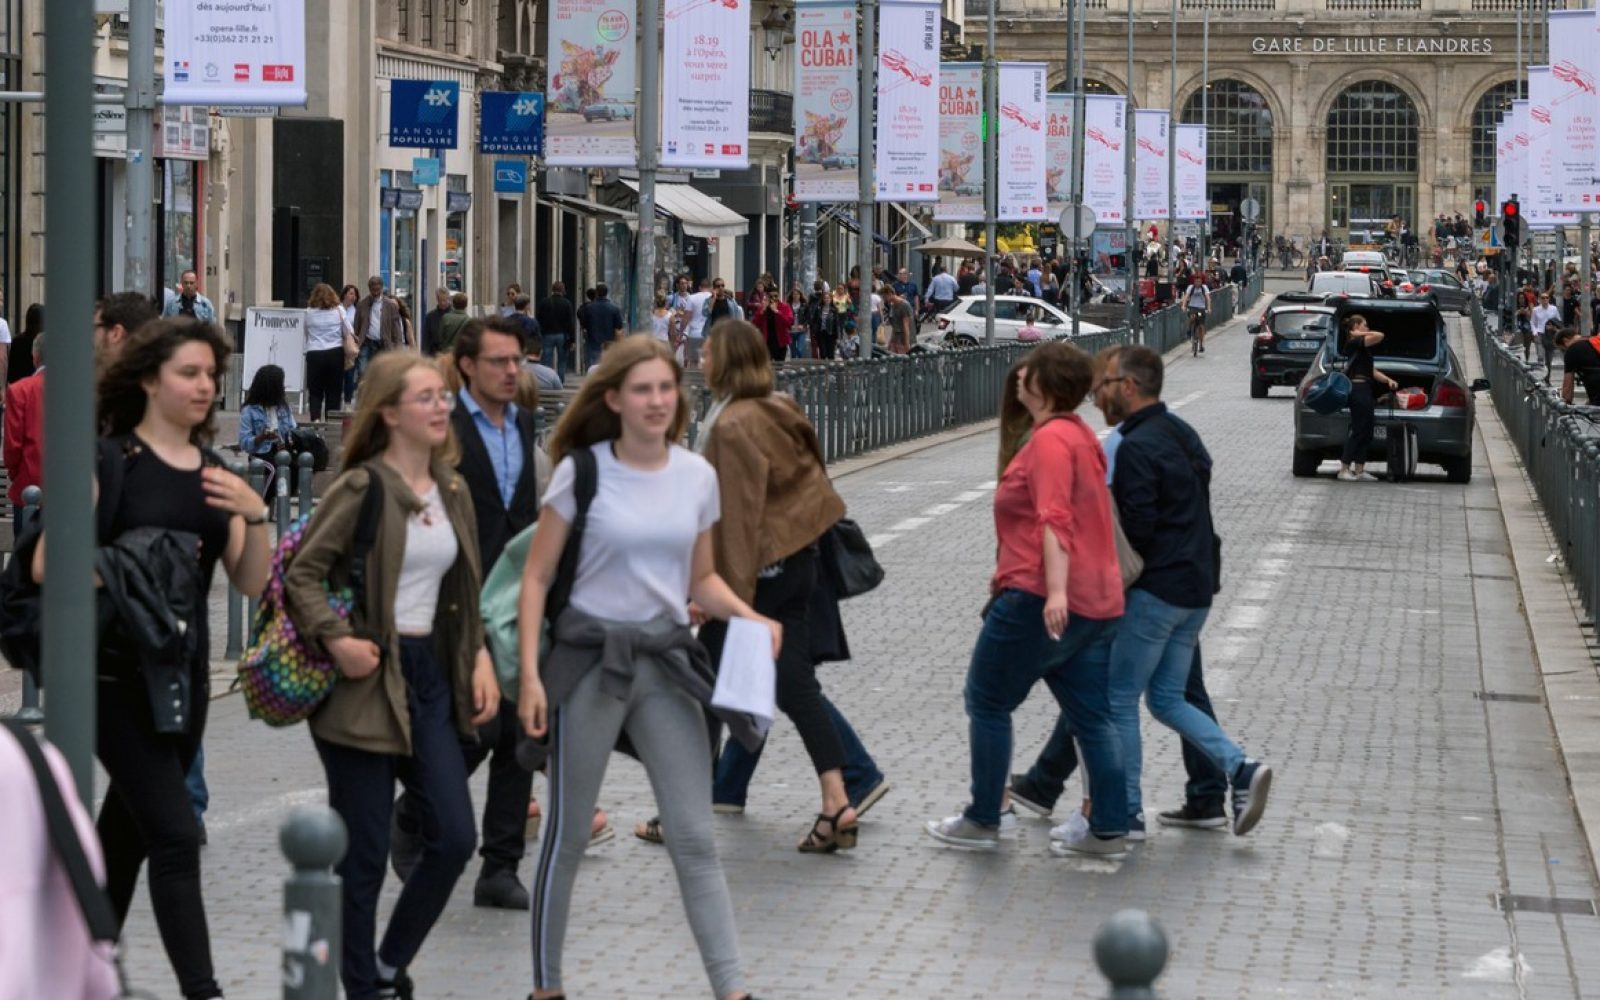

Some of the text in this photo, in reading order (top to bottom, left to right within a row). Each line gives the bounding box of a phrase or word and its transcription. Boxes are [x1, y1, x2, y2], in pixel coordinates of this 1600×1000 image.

[196, 3, 212, 11] dès
[214, 3, 267, 13] aujourd'hui
[925, 10, 934, 24] LILLE
[194, 35, 236, 43] +33(0)362
[694, 34, 720, 46] 18.19
[801, 30, 833, 48] OLA
[1252, 37, 1492, 52] GARE DE LILLE FLANDRES
[693, 47, 726, 58] l'Opéra,
[801, 48, 853, 67] CUBA!
[690, 73, 721, 82] surpris
[939, 86, 963, 100] OLA
[939, 100, 979, 115] CUBA!
[393, 127, 453, 136] BANQUE
[393, 136, 452, 145] POPULAIRE
[483, 143, 538, 151] POPULAIRE
[254, 312, 300, 329] Promesse
